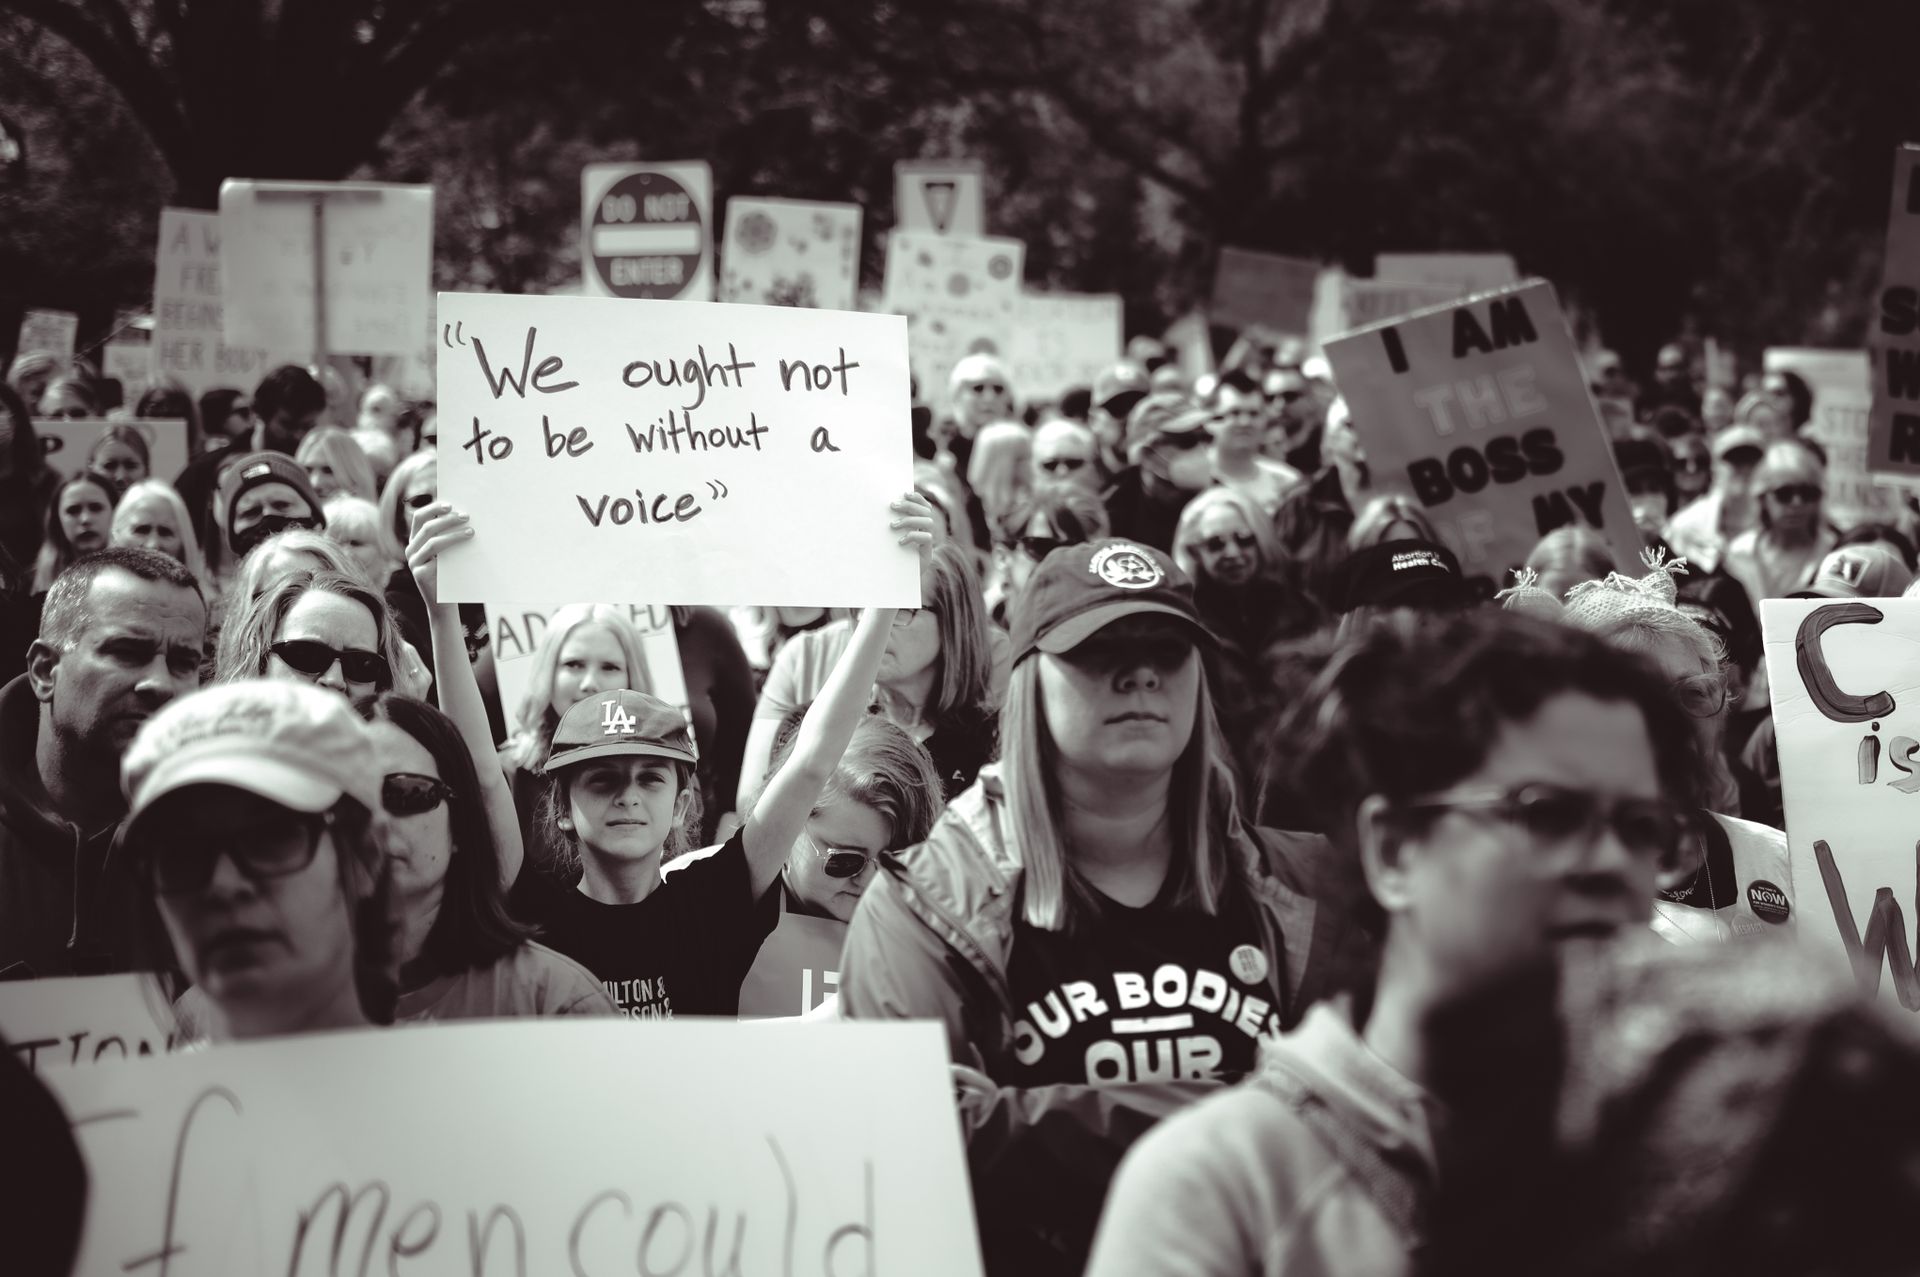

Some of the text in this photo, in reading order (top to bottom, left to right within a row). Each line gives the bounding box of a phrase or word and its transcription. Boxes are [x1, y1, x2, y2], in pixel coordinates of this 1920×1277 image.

[602, 192, 691, 223] DO NOT
[610, 256, 684, 287] ENTER
[1380, 326, 1409, 374] I
[1453, 297, 1538, 358] AM
[622, 343, 755, 410] ought
[779, 347, 860, 395] not
[1413, 364, 1547, 436] THE
[463, 410, 840, 464] to be without a
[1407, 428, 1565, 507] BOSS
[1533, 482, 1606, 537] MY
[1392, 550, 1432, 562] Abortion
[1392, 558, 1429, 571] Health
[602, 700, 636, 735] LA
[1858, 721, 1920, 794] is
[1750, 888, 1785, 906] NOW
[1013, 964, 1281, 1066] OUR BODIES
[1084, 1035, 1224, 1085] OUR
[568, 1132, 875, 1277] could
